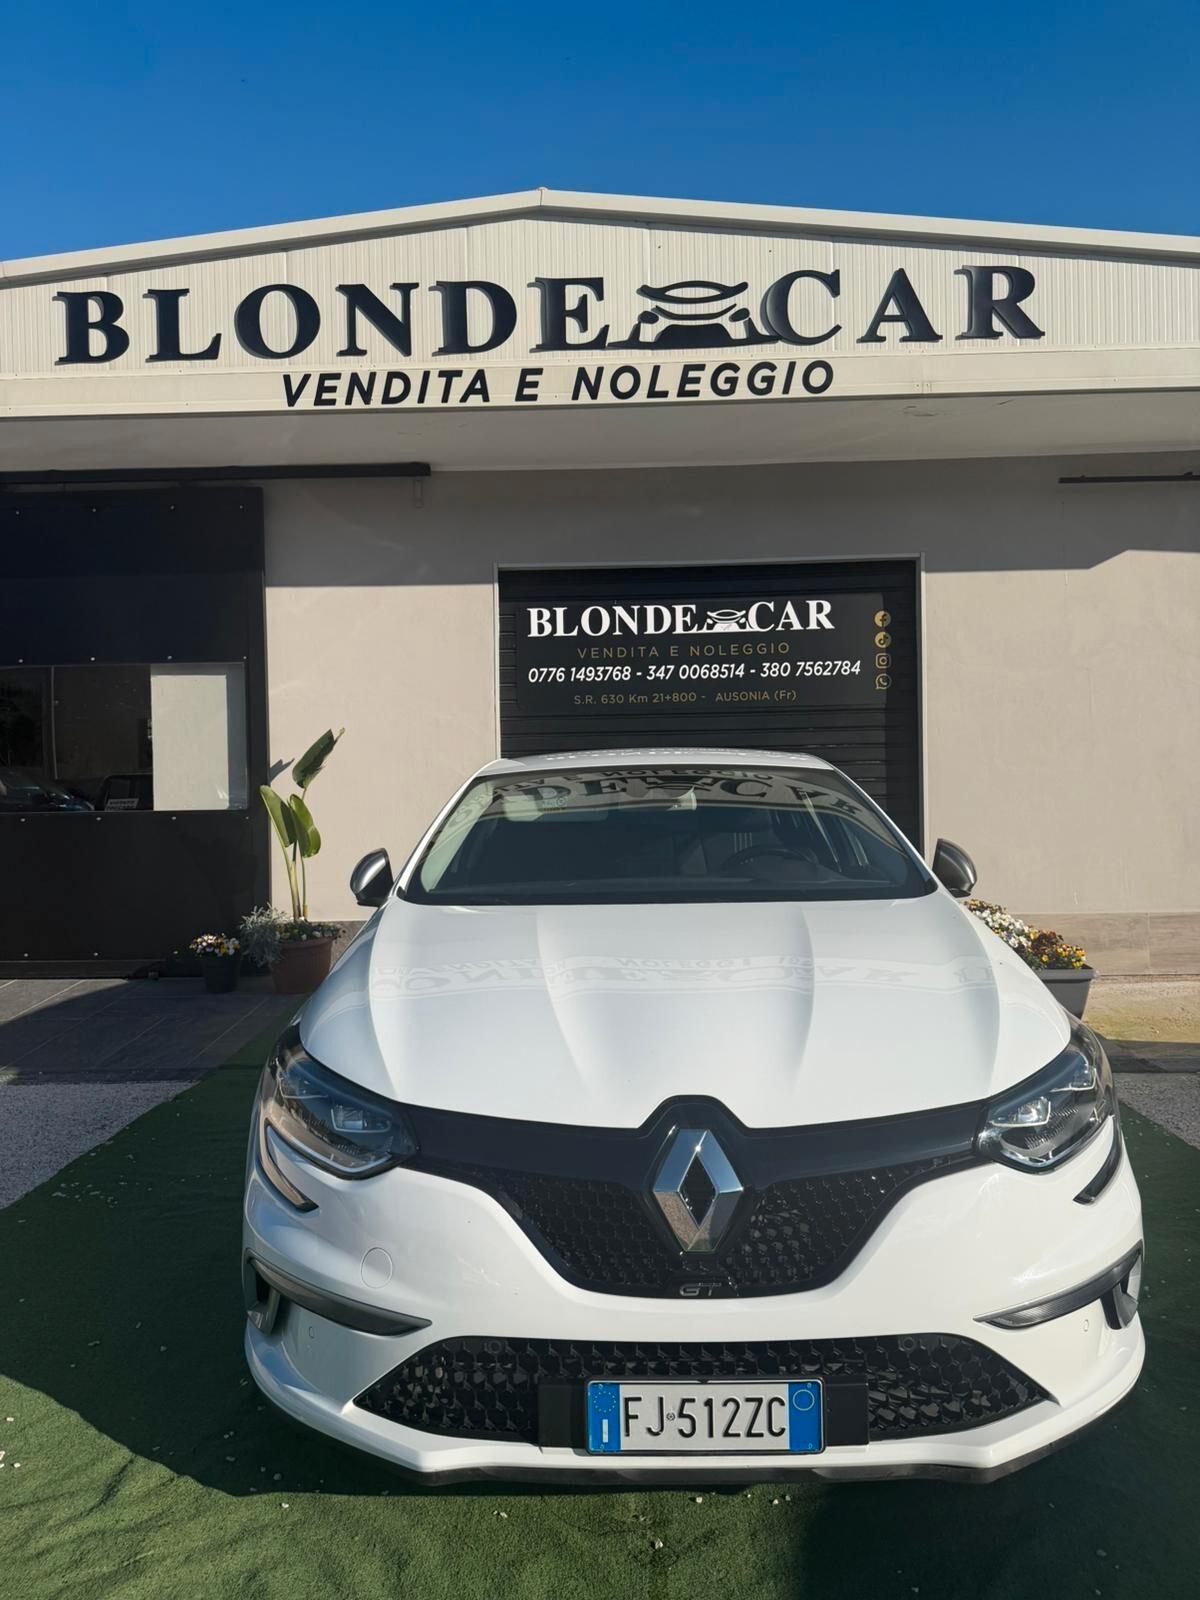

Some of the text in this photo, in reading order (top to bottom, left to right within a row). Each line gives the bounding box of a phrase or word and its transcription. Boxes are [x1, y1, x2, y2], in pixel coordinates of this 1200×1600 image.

[52, 265, 1046, 366] BLONDE CAR
[283, 360, 834, 407] VENDITA E NOLEGGIO
[527, 600, 835, 637] BLONDE CAR
[577, 642, 790, 658] VENDITA E NOLEGGIO
[528, 667, 565, 682] 0776
[570, 666, 631, 681] 1493768
[647, 665, 674, 680] 347
[679, 663, 745, 679] 0068514
[760, 662, 791, 677] 380
[796, 660, 861, 676] 7562784
[574, 695, 597, 704] S.R.
[601, 693, 624, 704] 630
[629, 693, 648, 703] Km
[652, 692, 697, 703] 21+800
[715, 691, 770, 702] AUSONIA
[774, 689, 798, 700] (Fr)
[680, 1283, 722, 1296] GT
